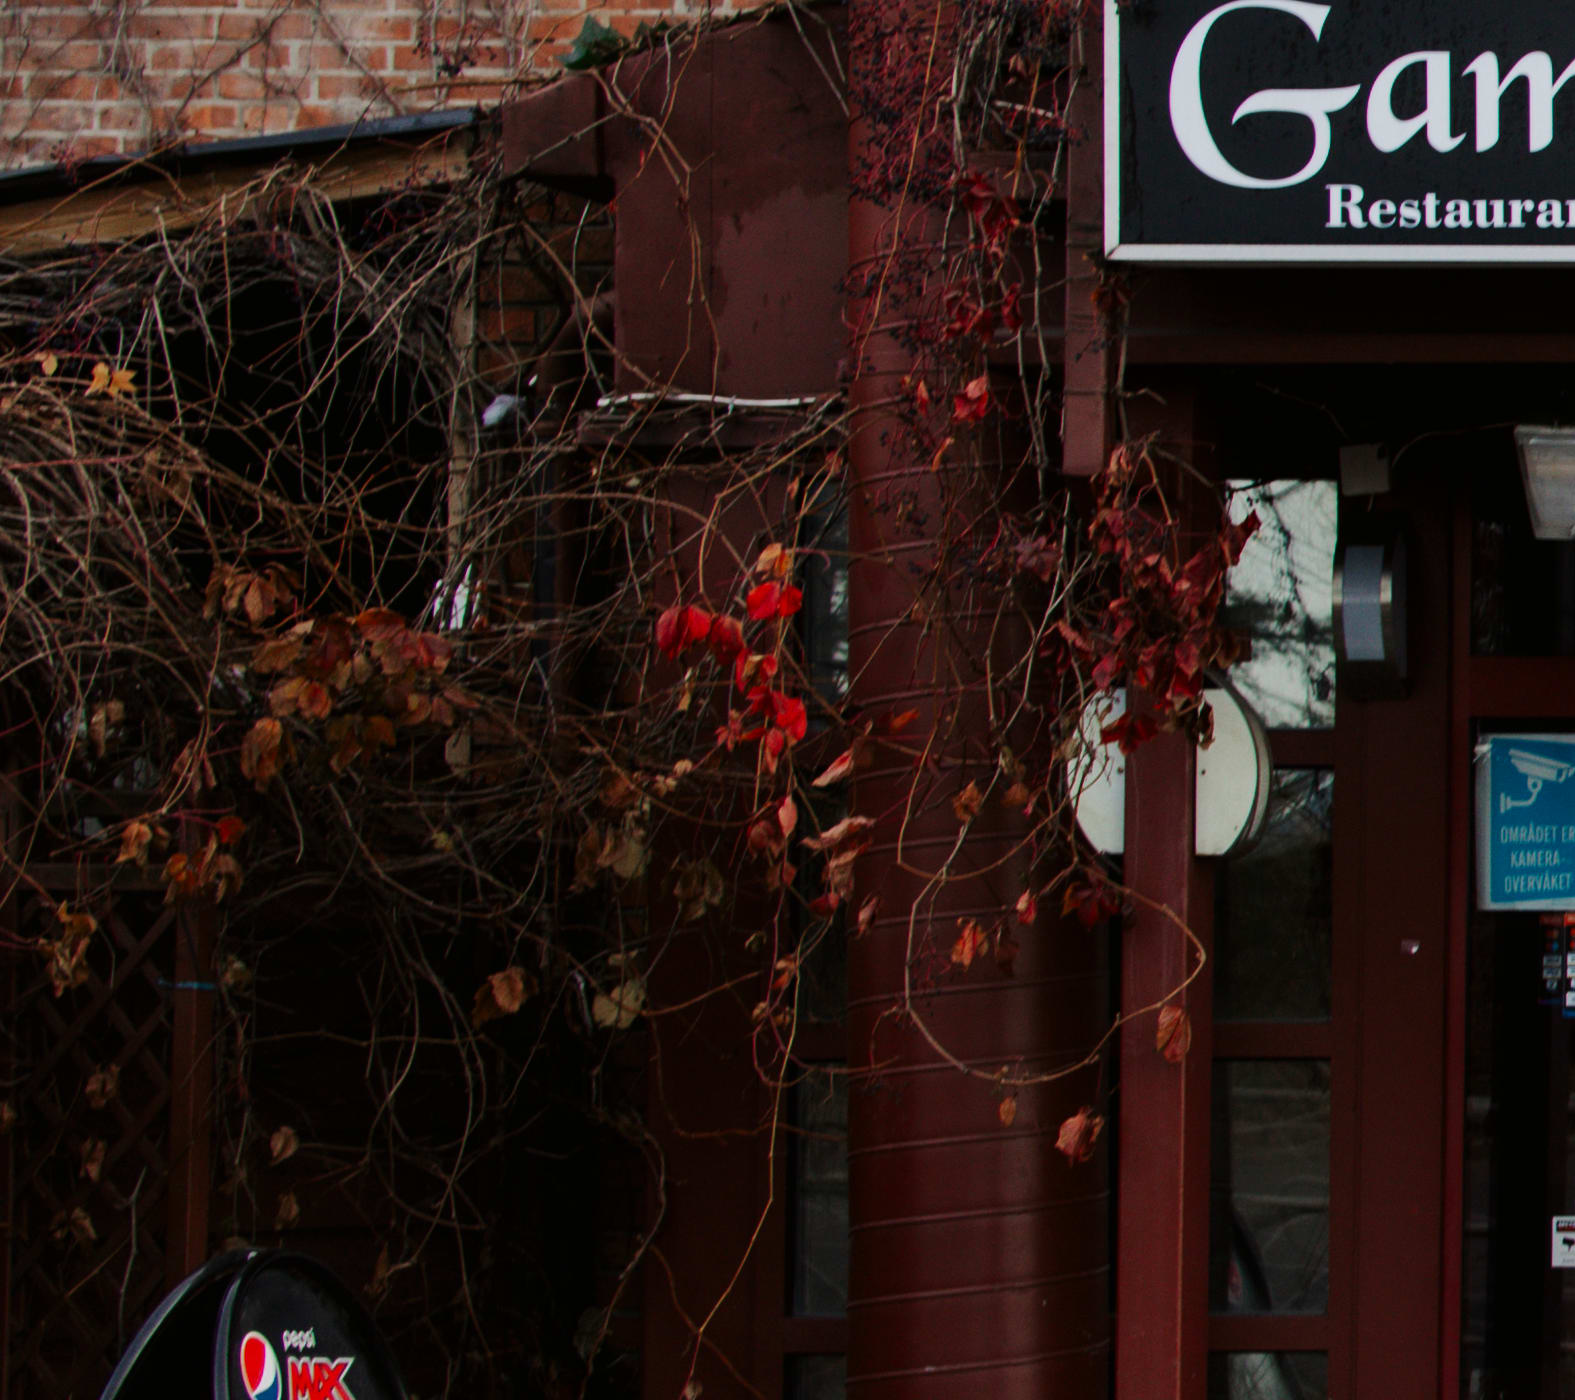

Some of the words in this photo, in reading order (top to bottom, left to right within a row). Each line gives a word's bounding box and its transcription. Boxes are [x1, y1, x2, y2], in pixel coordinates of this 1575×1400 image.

[1501, 821, 1558, 843] OMRÅDET
[1561, 825, 1575, 843] ER
[1504, 871, 1572, 893] OVERVÅKET
[283, 1327, 316, 1352] pepsi
